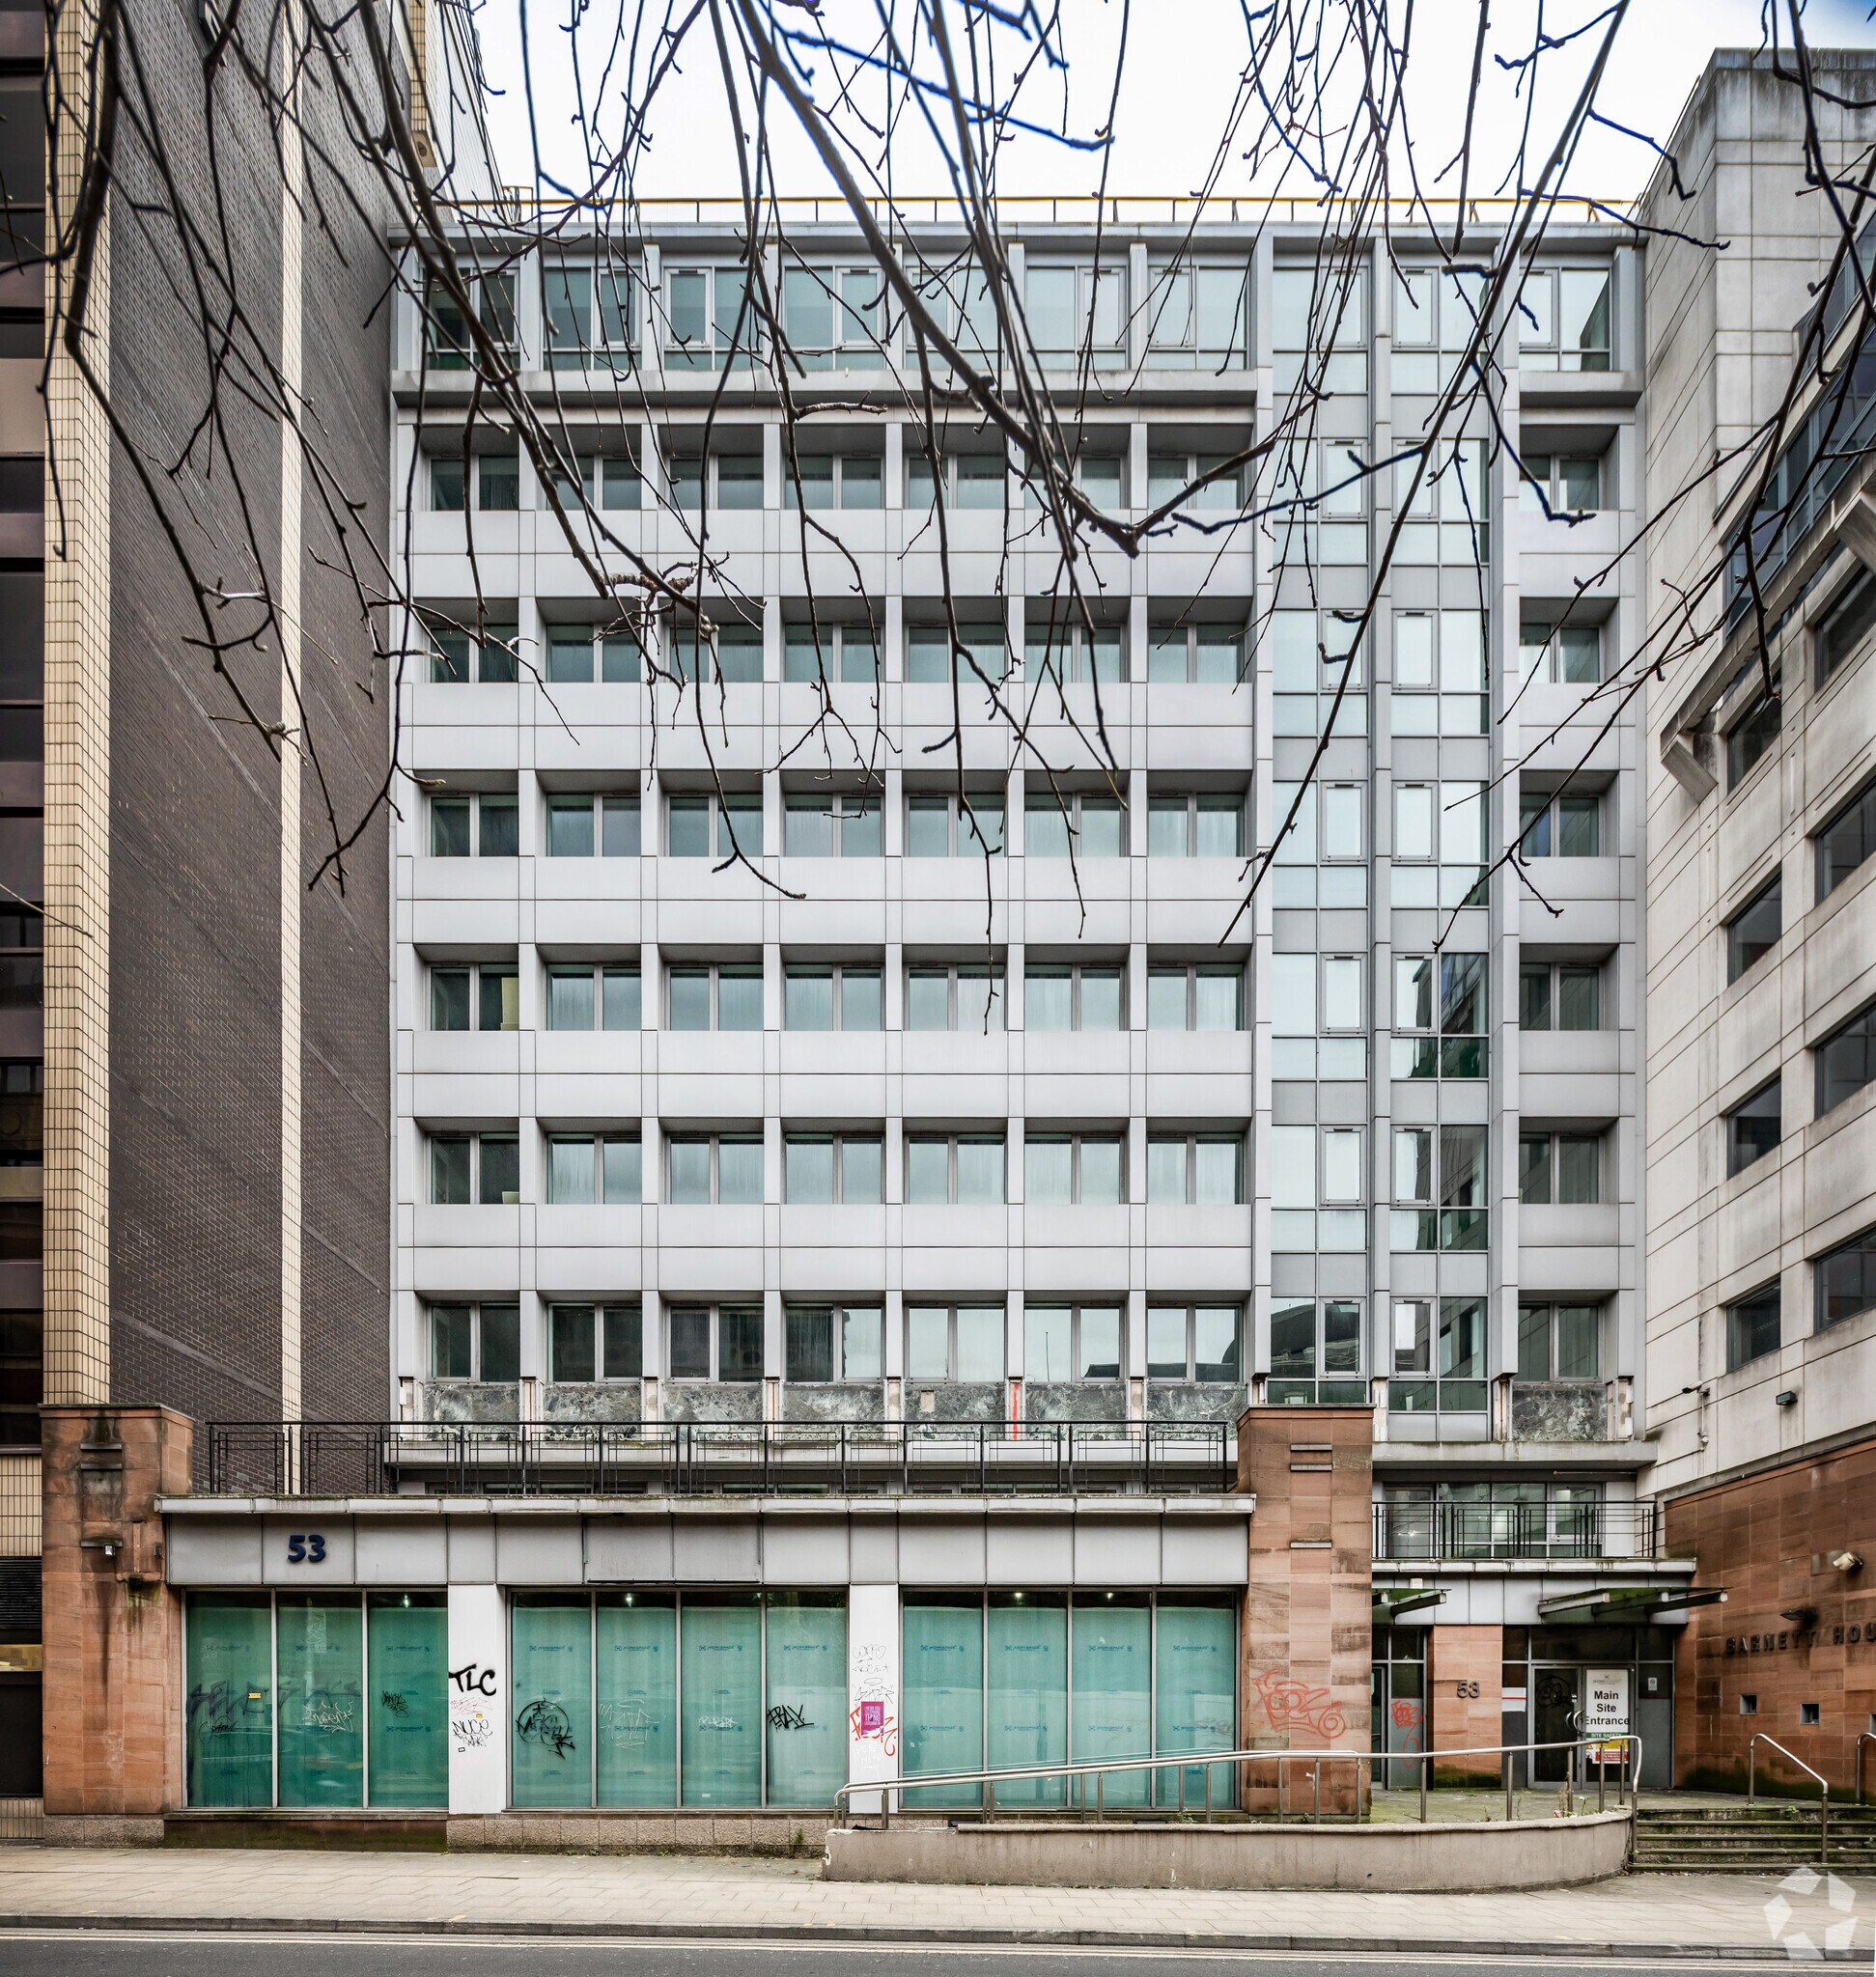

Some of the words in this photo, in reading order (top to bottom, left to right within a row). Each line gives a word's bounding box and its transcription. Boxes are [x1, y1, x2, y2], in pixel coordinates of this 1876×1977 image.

[288, 1535, 325, 1562] 53
[1726, 1629, 1816, 1656] BARNETT
[448, 1663, 496, 1696] TLC
[1457, 1681, 1479, 1698] 53
[1594, 1690, 1619, 1700] Main
[1596, 1703, 1616, 1712] Site
[1585, 1716, 1630, 1725] Entrance
